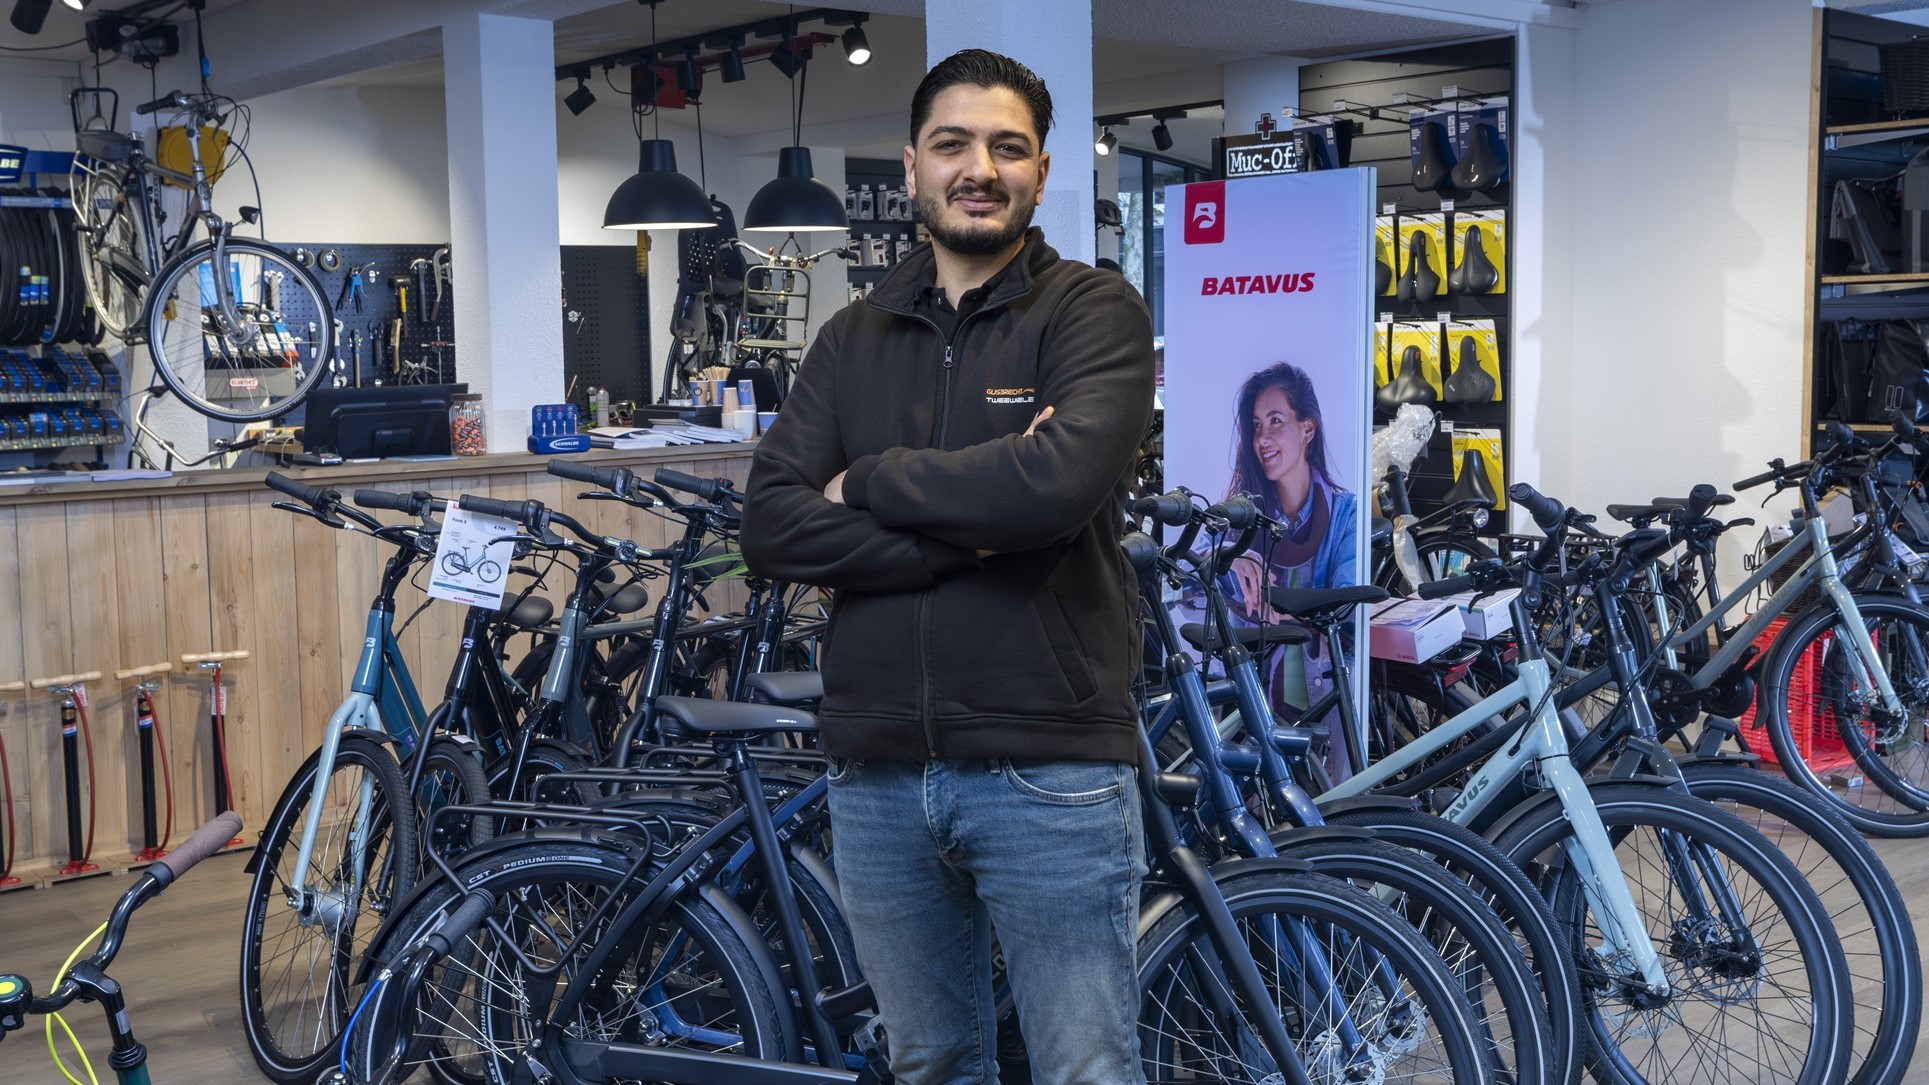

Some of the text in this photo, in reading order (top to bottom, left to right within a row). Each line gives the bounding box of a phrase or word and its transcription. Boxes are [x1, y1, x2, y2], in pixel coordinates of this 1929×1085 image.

[0, 158, 20, 169] BE
[1201, 272, 1316, 296] BATAVUS
[1444, 775, 1489, 822] AVUS
[468, 869, 491, 884] CST
